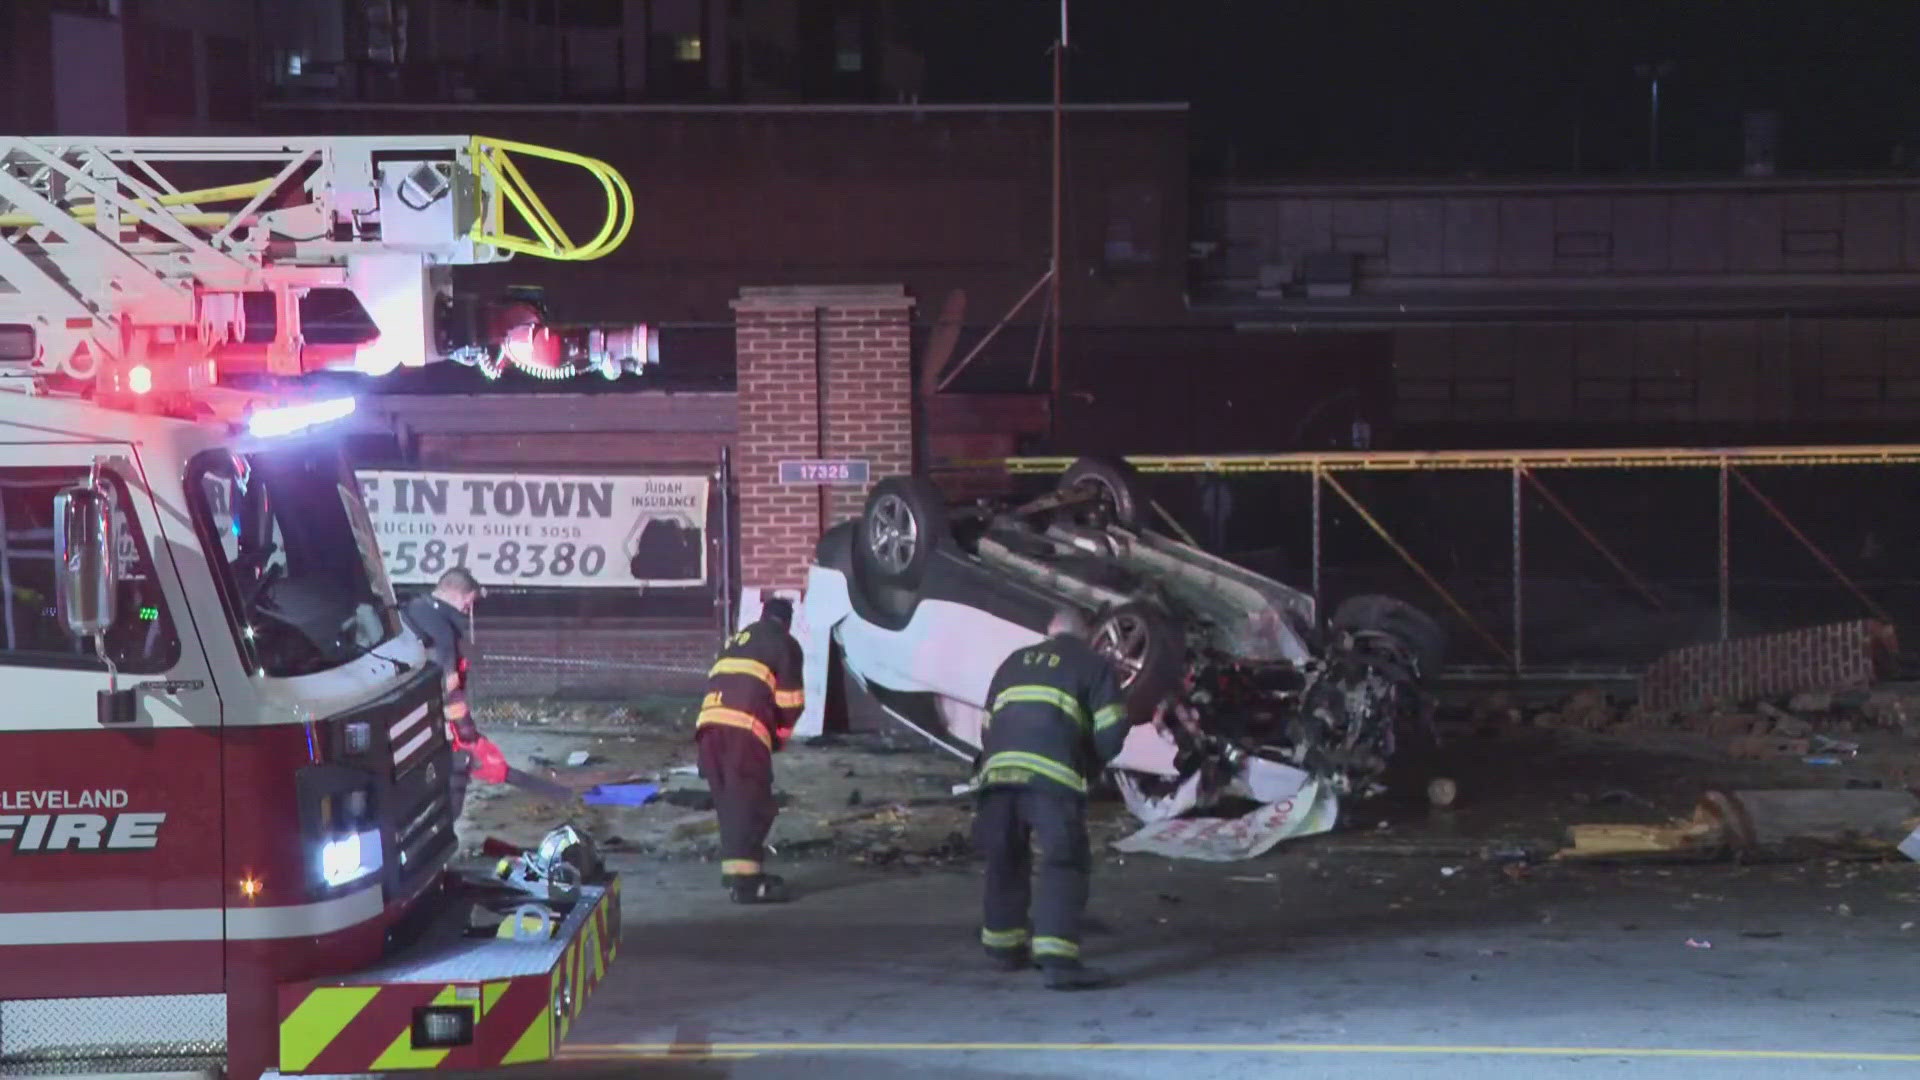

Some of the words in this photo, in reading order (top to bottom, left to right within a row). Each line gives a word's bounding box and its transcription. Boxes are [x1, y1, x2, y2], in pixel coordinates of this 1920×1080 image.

[800, 464, 849, 480] 17325
[645, 481, 682, 494] JUDAH
[393, 478, 449, 515] IN
[462, 480, 614, 518] TOWN
[631, 495, 696, 508] INSURANCE
[443, 522, 475, 537] AVE
[483, 524, 531, 538] SUITE
[0, 789, 129, 810] LEVELAND
[0, 812, 167, 851] FIRE
